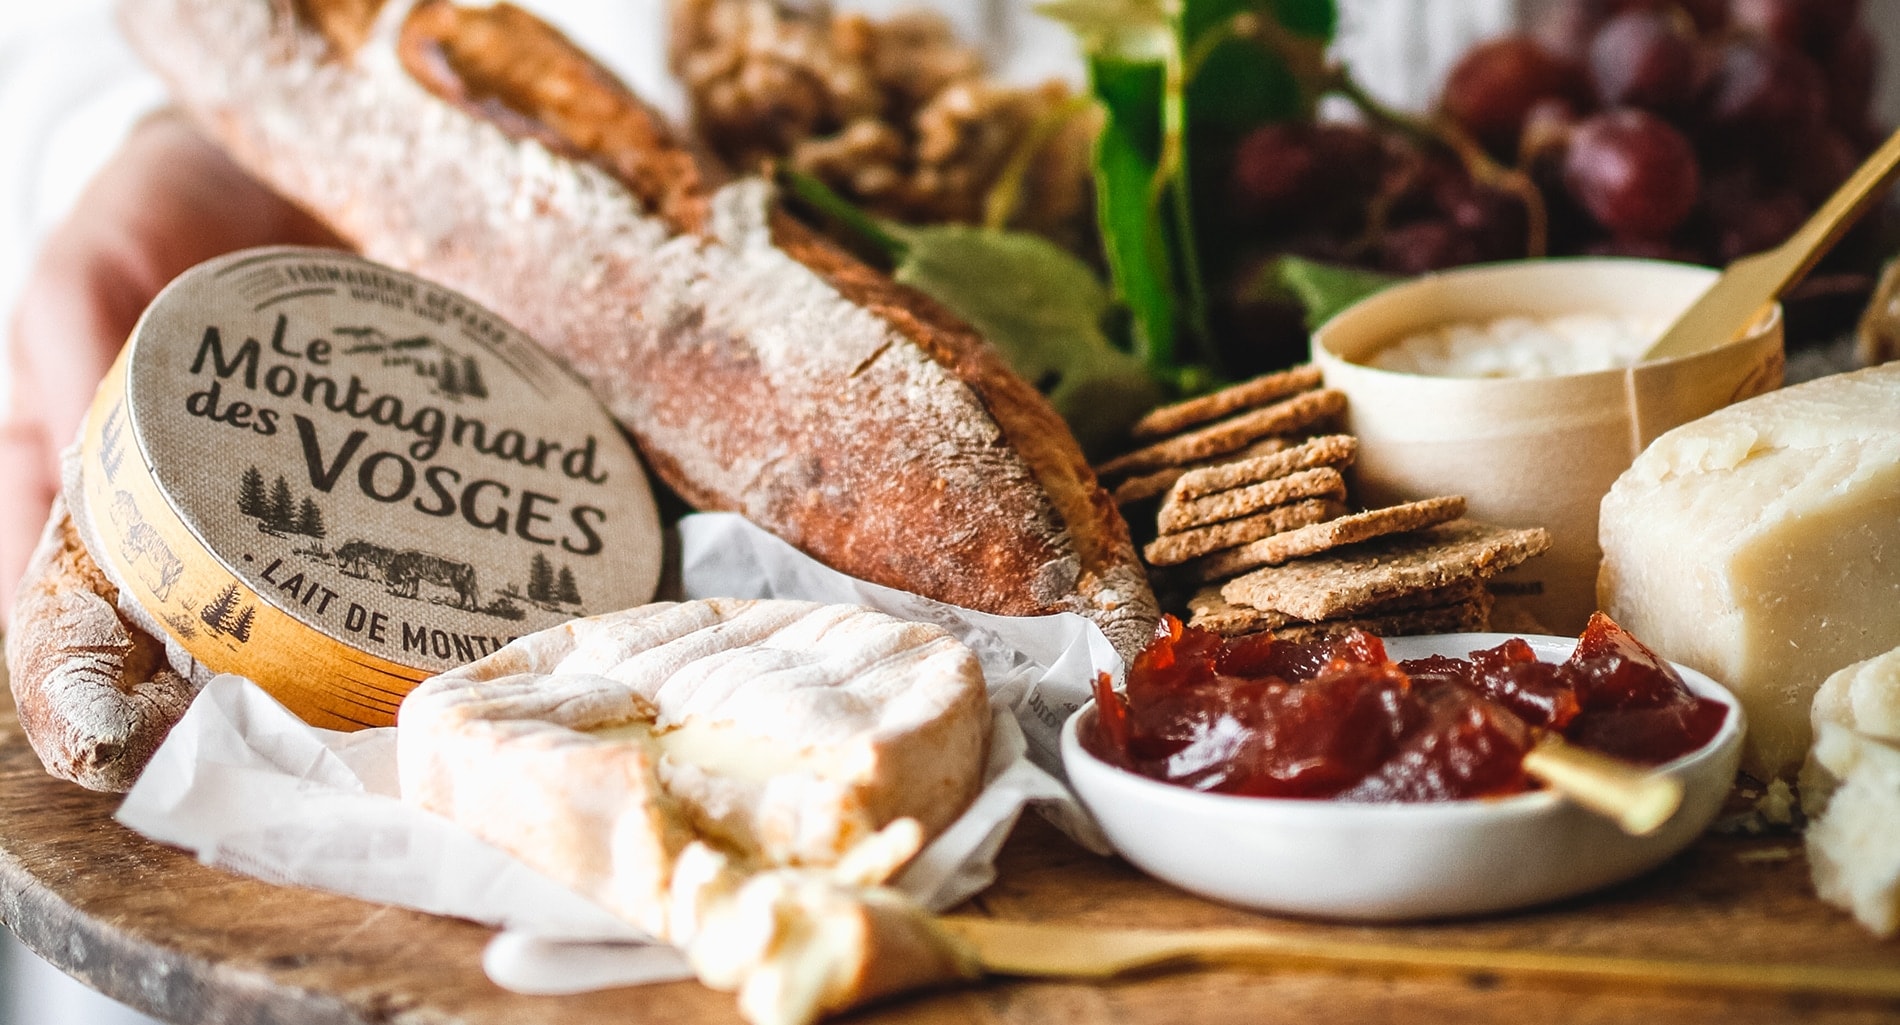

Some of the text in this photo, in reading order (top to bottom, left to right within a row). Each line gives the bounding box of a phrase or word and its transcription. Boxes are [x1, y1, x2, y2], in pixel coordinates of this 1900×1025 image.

[271, 313, 332, 366] Le
[189, 325, 607, 485] Montagnard
[186, 383, 607, 556] des VOSGES
[260, 557, 339, 614] LAIT
[344, 602, 389, 644] DE
